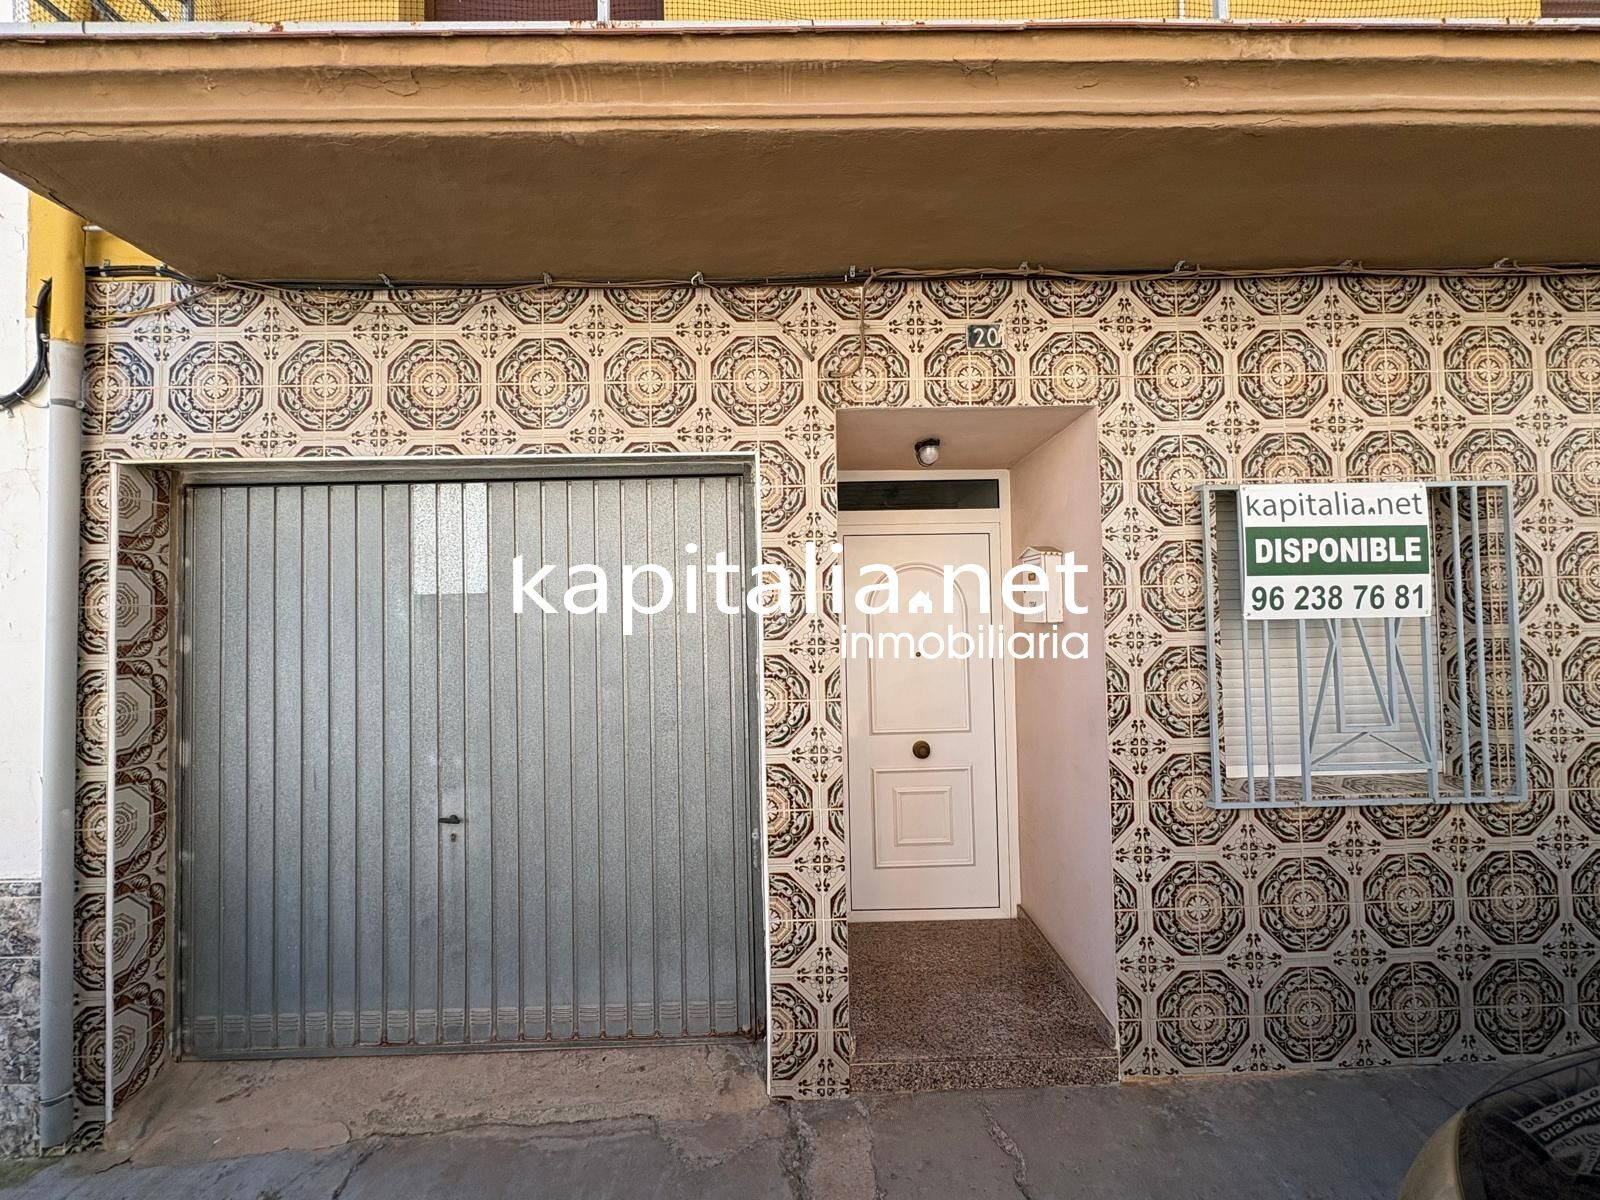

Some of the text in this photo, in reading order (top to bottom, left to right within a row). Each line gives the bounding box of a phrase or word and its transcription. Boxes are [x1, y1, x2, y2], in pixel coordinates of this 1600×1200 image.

[973, 327, 999, 348] 20
[1246, 490, 1423, 522] kapitalia.net
[1254, 536, 1422, 564] DISPONIBLE
[1251, 583, 1424, 611] 96 238 76 81
